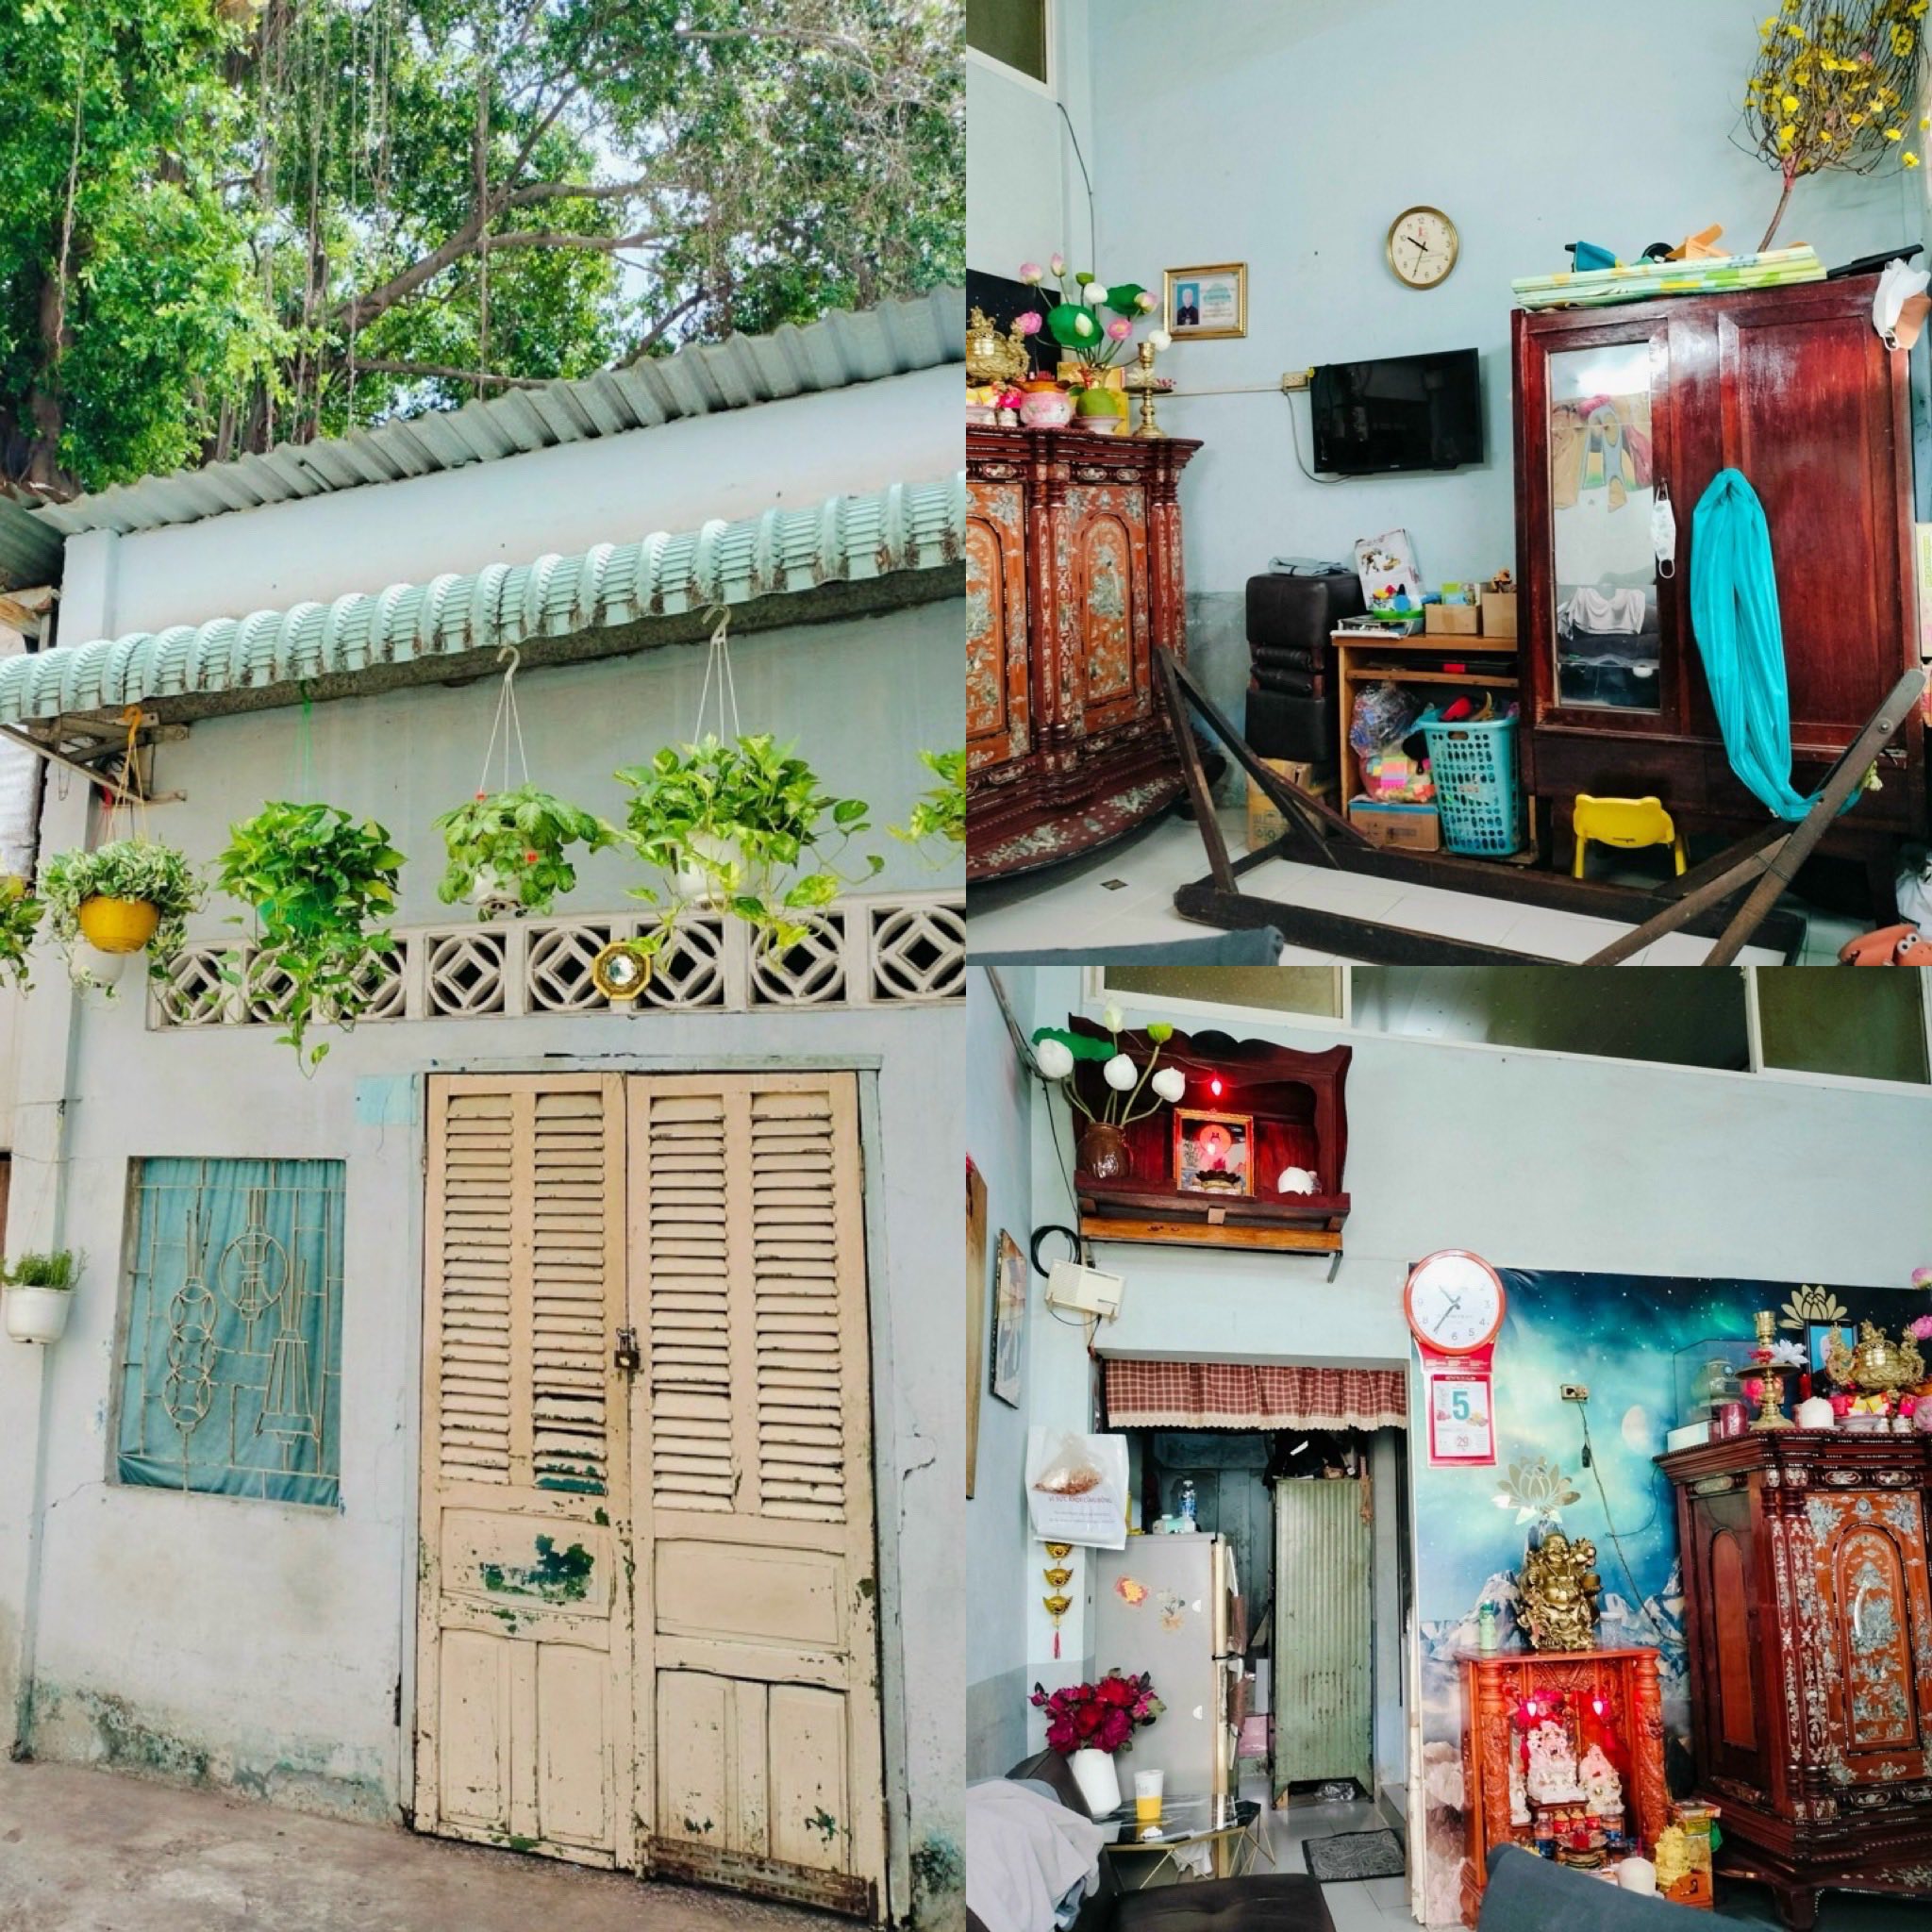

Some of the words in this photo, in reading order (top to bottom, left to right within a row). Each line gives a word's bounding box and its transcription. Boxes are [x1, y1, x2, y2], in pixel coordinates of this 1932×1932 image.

[1452, 1331, 1457, 1341] 6
[1469, 1327, 1474, 1337] 5
[1452, 1391, 1470, 1421] 5
[1457, 1436, 1469, 1446] 29
